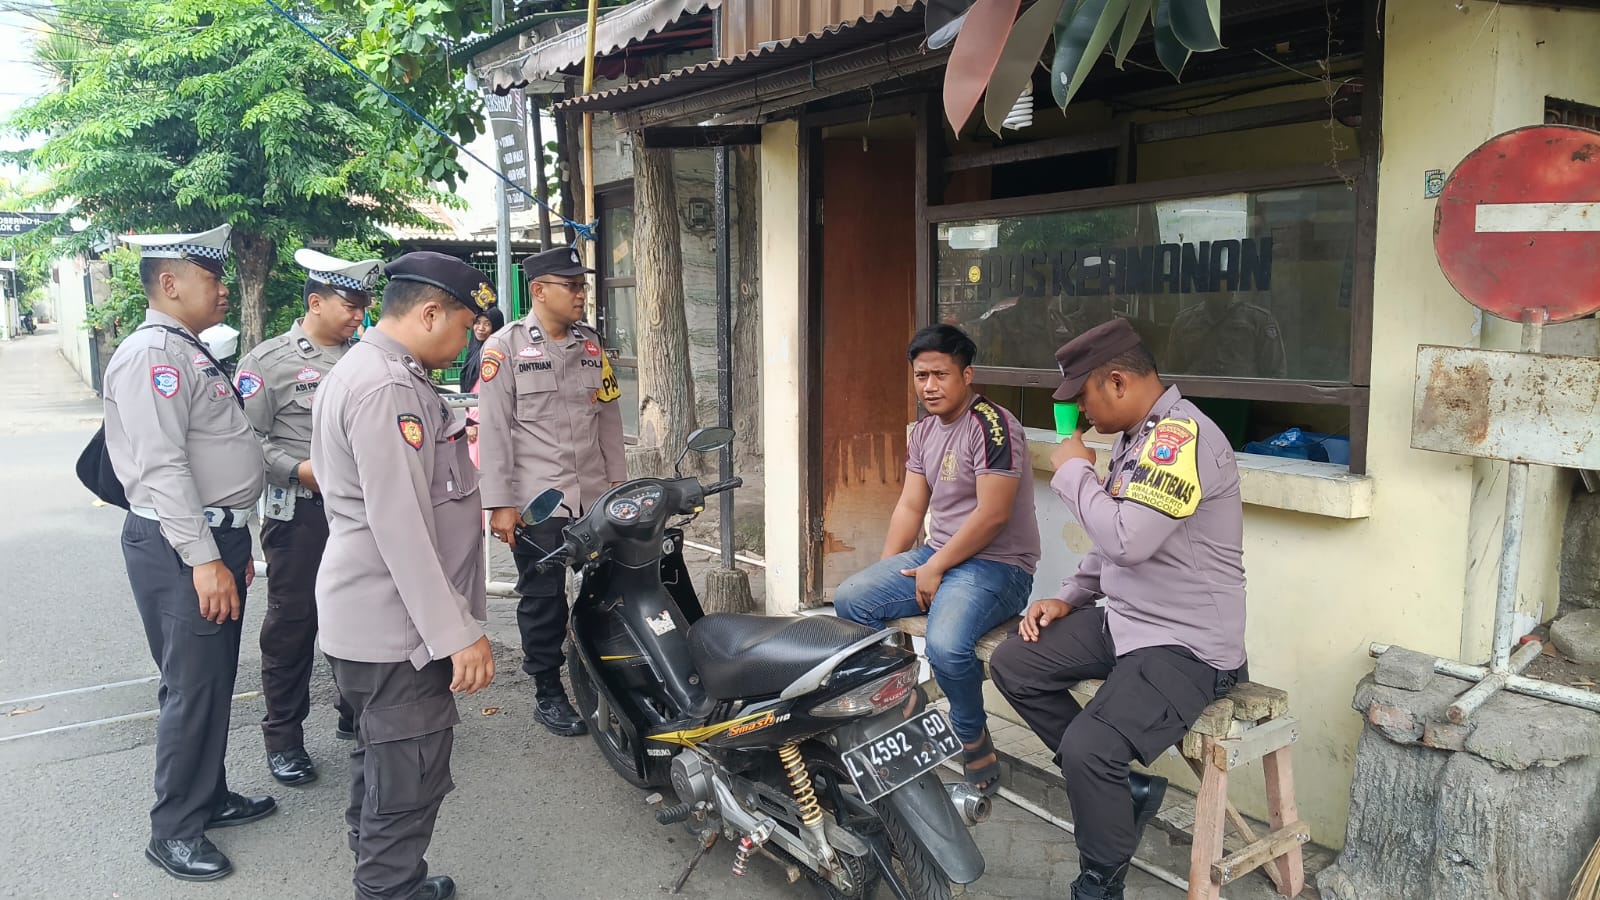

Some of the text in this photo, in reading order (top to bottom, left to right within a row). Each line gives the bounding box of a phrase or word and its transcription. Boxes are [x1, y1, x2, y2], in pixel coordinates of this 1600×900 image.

[728, 712, 775, 737] Smash
[847, 713, 946, 777] L 4592 GD
